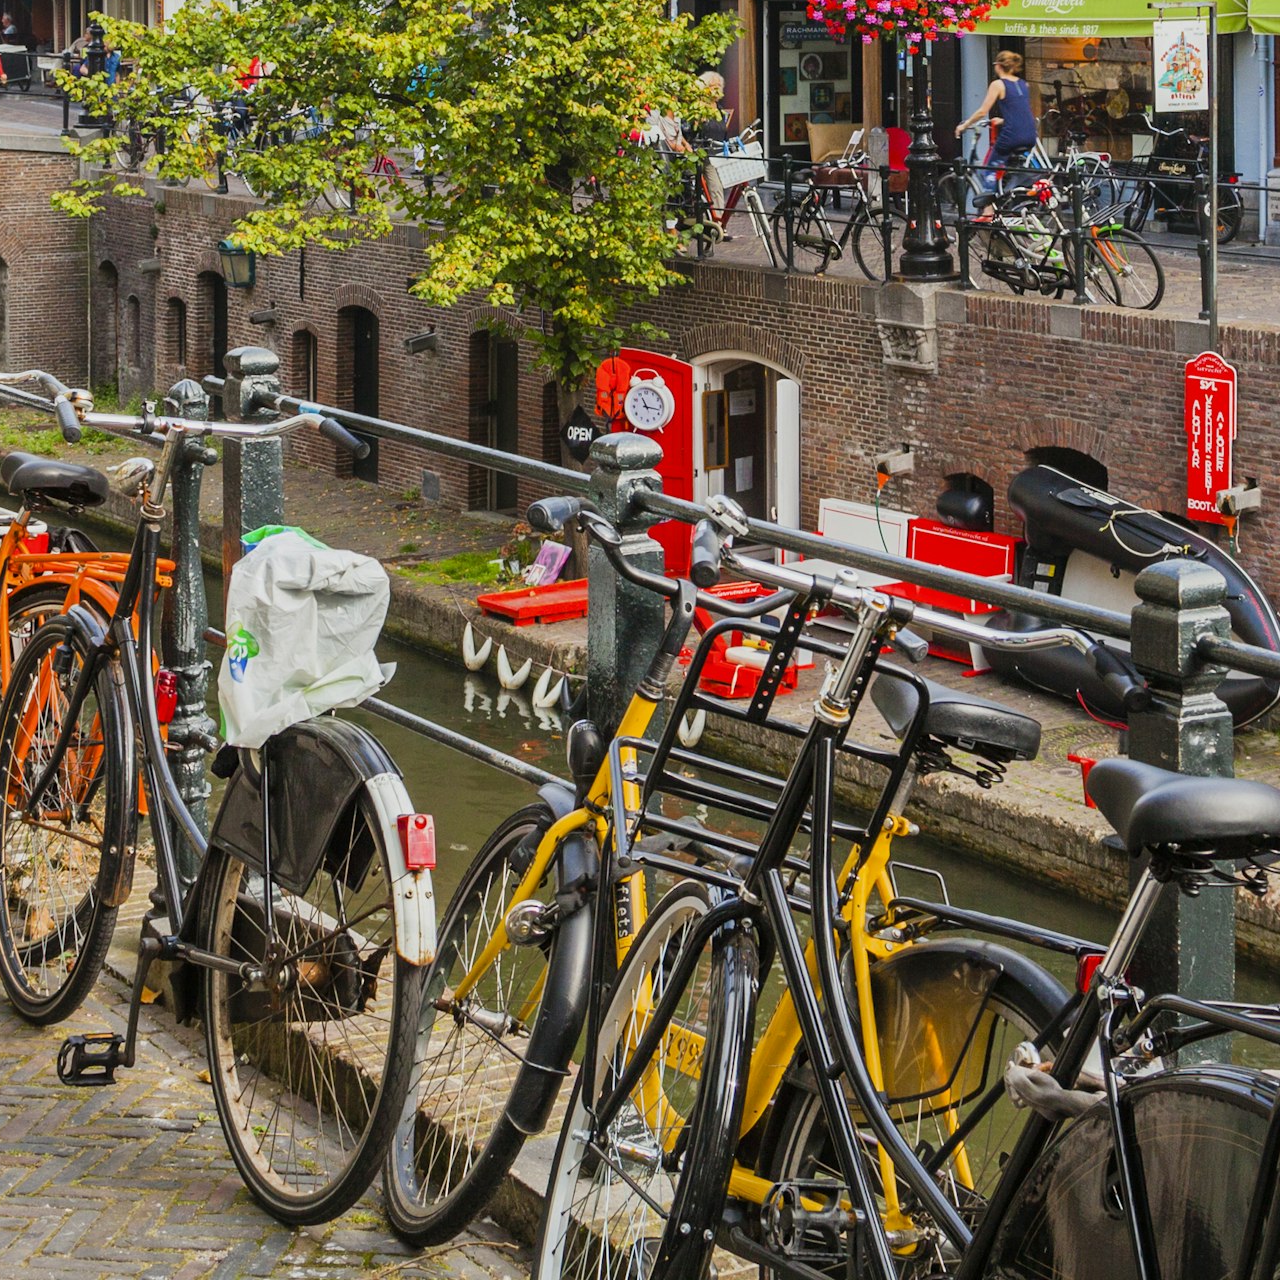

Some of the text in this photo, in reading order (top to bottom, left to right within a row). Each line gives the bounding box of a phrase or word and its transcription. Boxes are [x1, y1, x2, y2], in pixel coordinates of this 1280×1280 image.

[1004, 22, 1099, 35] koffie & thee sinds 1817
[567, 426, 593, 441] OPEN
[617, 885, 630, 937] fiets
